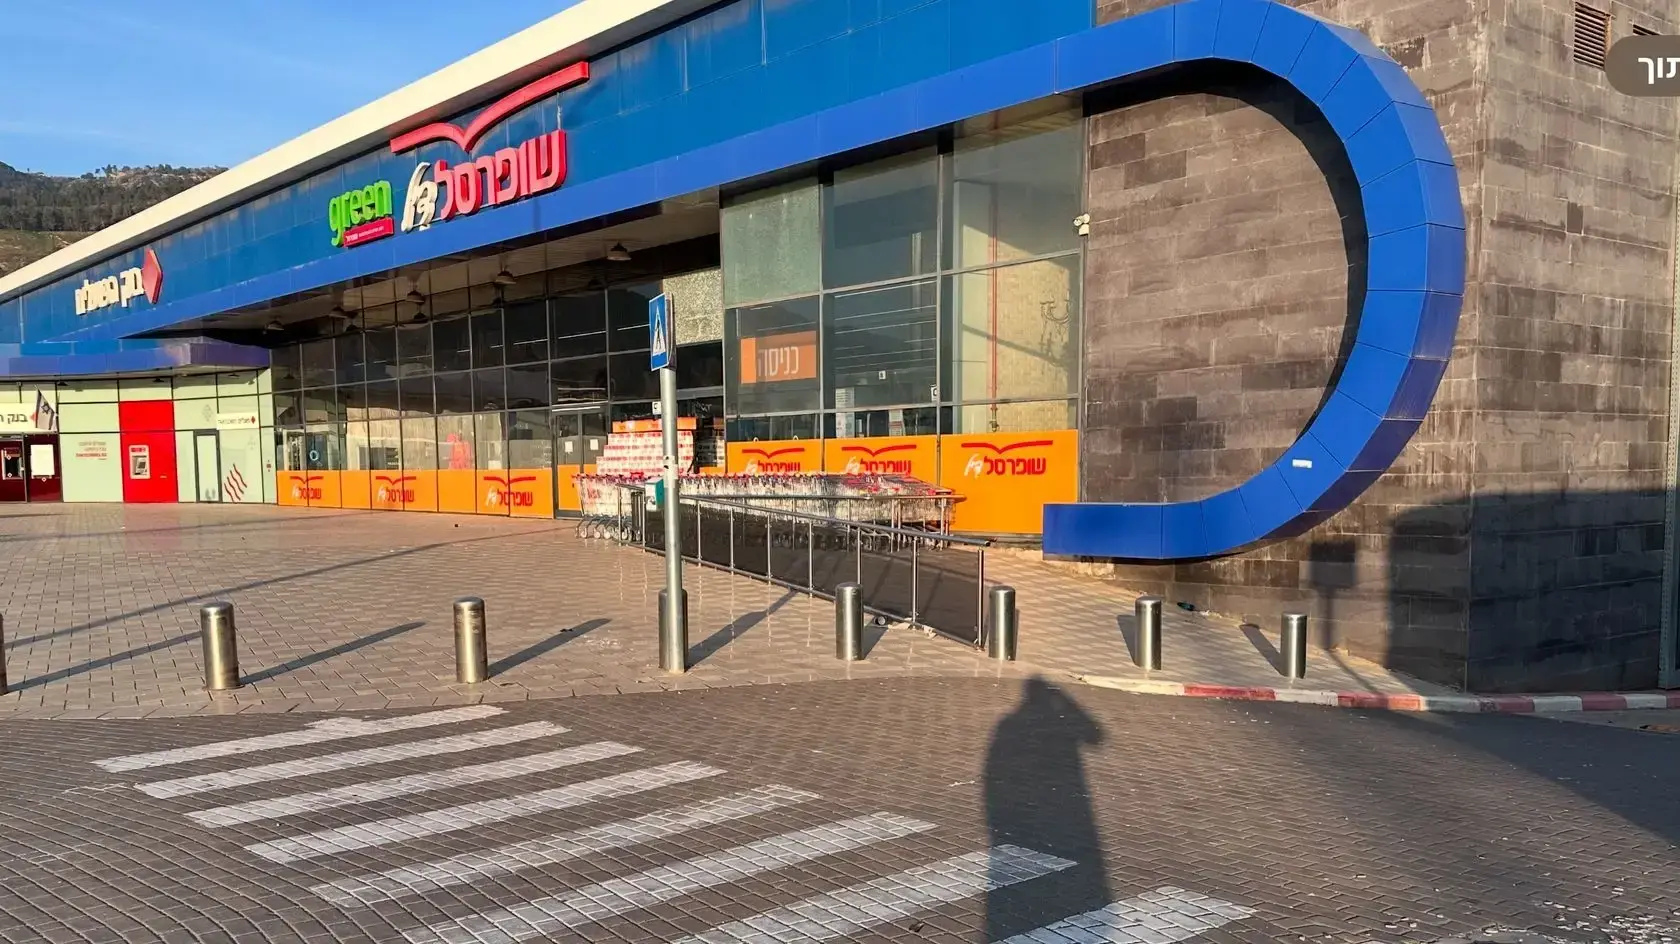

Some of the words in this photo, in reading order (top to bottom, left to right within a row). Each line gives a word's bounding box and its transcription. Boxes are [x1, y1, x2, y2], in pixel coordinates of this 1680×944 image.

[434, 129, 567, 222] שופרסל
[329, 180, 393, 247] green
[757, 346, 799, 378] כניסה
[7, 413, 28, 425] בנק
[983, 455, 1047, 476] שופרסל
